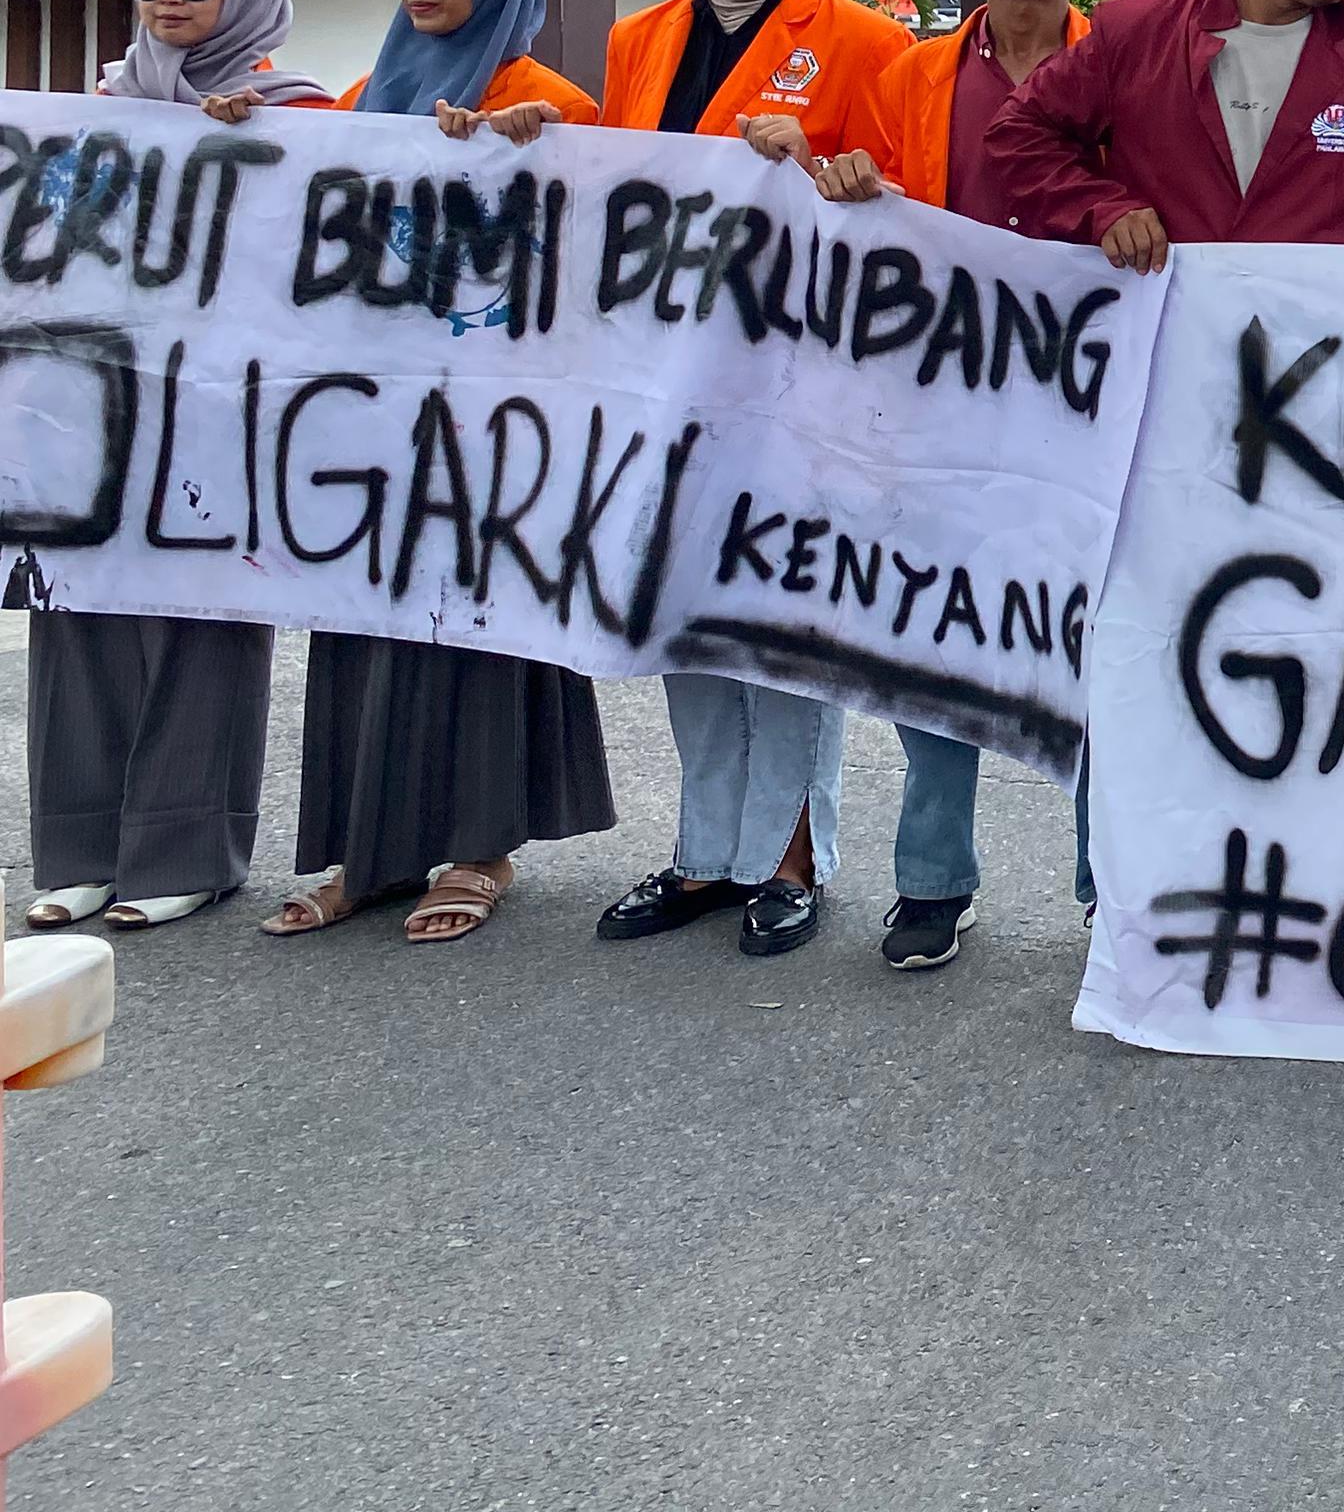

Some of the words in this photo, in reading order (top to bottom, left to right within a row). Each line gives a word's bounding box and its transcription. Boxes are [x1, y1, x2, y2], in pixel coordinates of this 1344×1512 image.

[292, 169, 566, 338] BUMI
[598, 178, 1121, 419] BERLUBANG
[715, 491, 1090, 681] KENYANG
